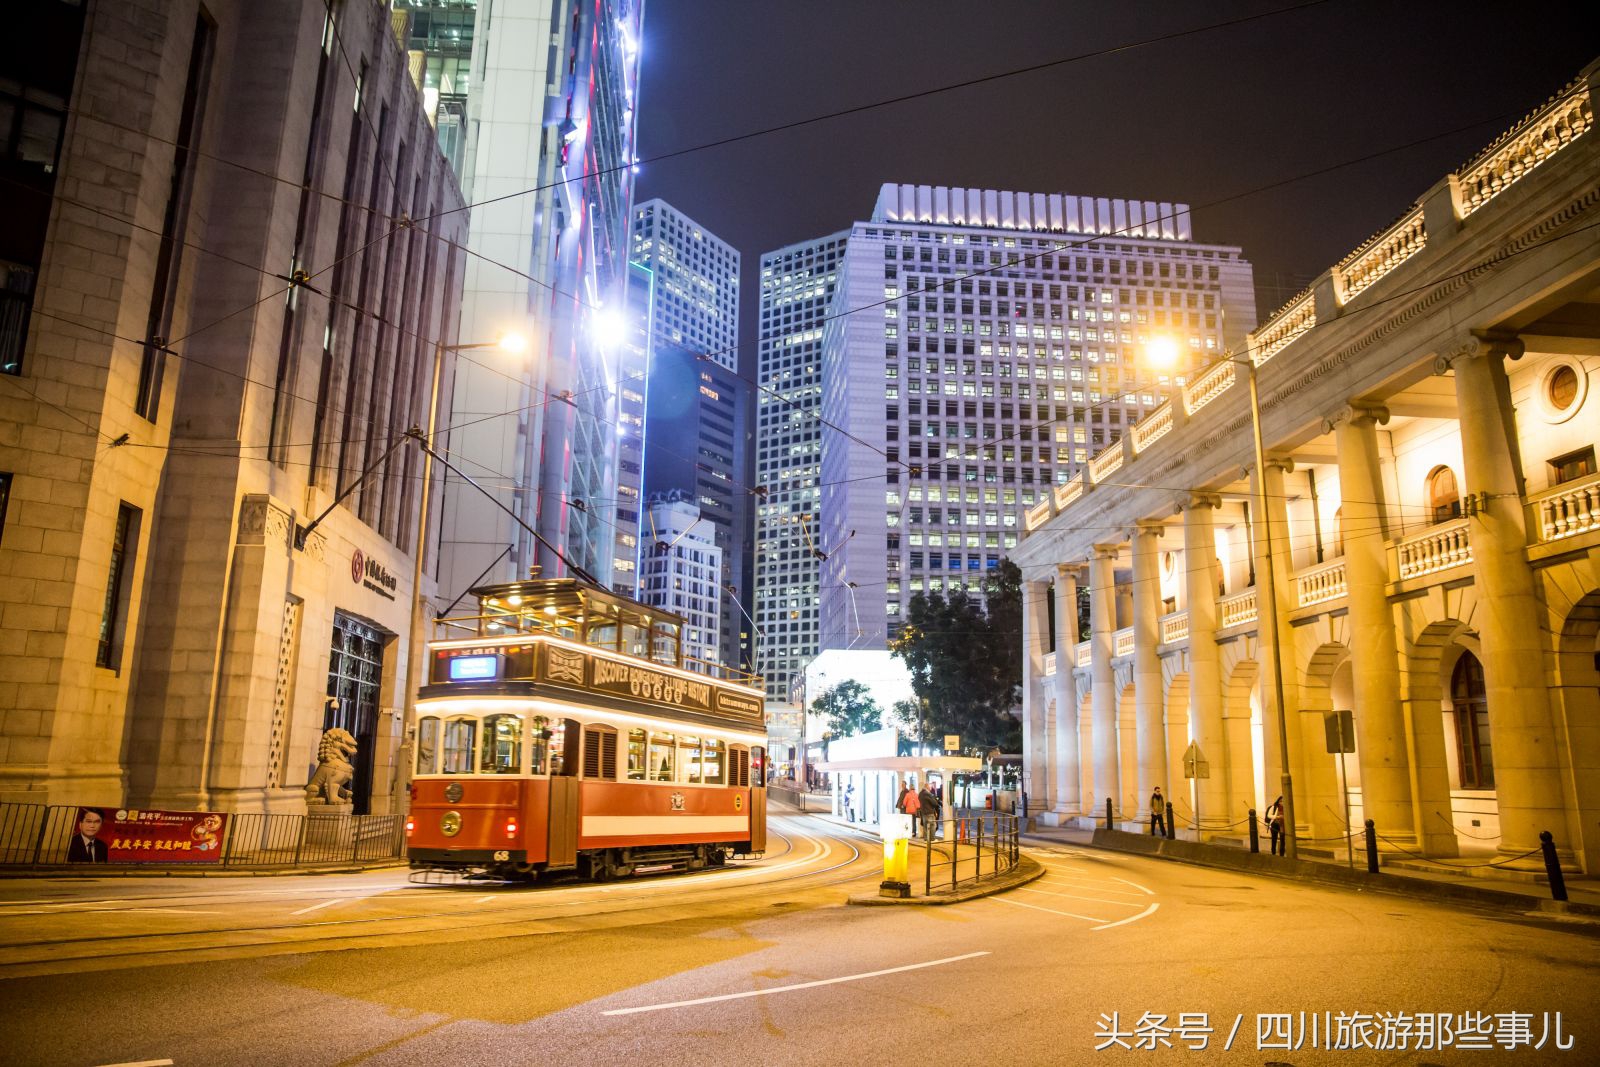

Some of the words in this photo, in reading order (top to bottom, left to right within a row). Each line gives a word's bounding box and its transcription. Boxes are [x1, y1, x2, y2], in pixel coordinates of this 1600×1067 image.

[594, 658, 628, 685] DISCOVER
[688, 682, 710, 707] HISTORY
[719, 695, 758, 711] hktramways.com
[494, 850, 509, 861] 68
